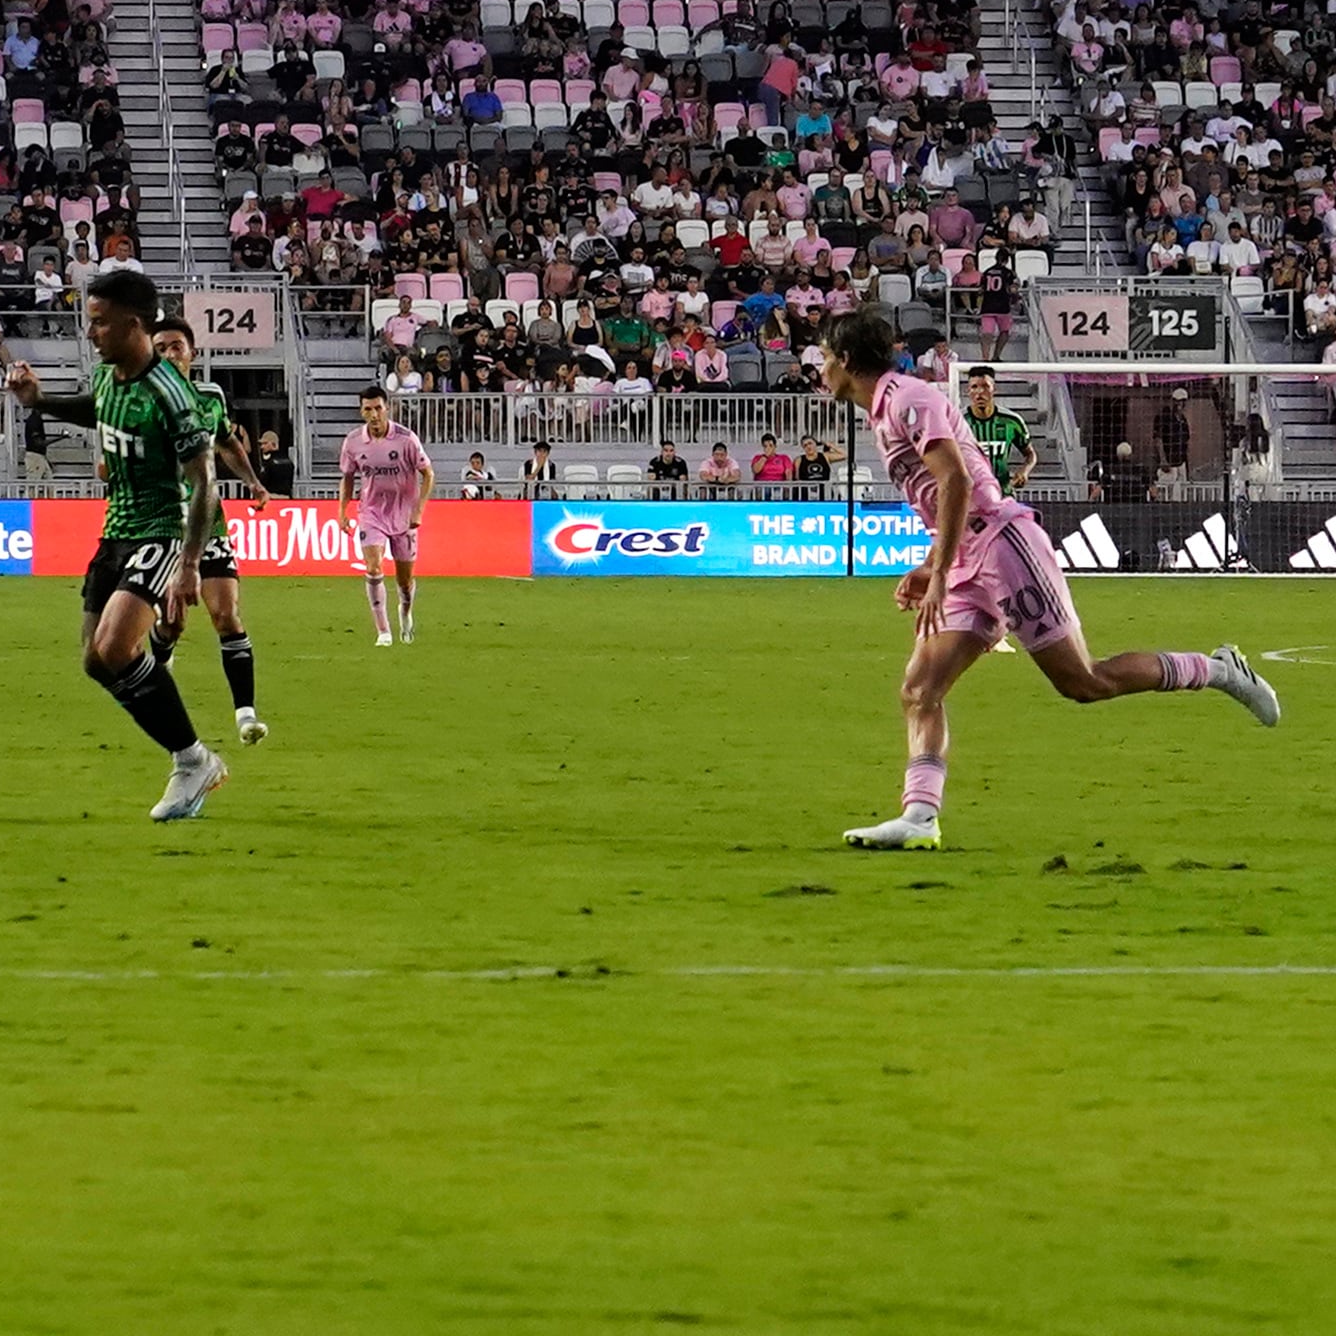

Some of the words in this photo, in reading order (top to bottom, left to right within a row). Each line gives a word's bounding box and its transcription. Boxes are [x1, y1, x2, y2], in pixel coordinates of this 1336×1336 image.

[203, 308, 257, 334] 124
[1058, 311, 1111, 336] 124
[1147, 309, 1200, 337] 125
[976, 440, 1007, 456] ETI
[749, 514, 796, 536] THE
[801, 515, 826, 535] #1
[553, 521, 707, 559] Crest
[753, 544, 836, 565] BRAND
[996, 584, 1046, 632] 30
